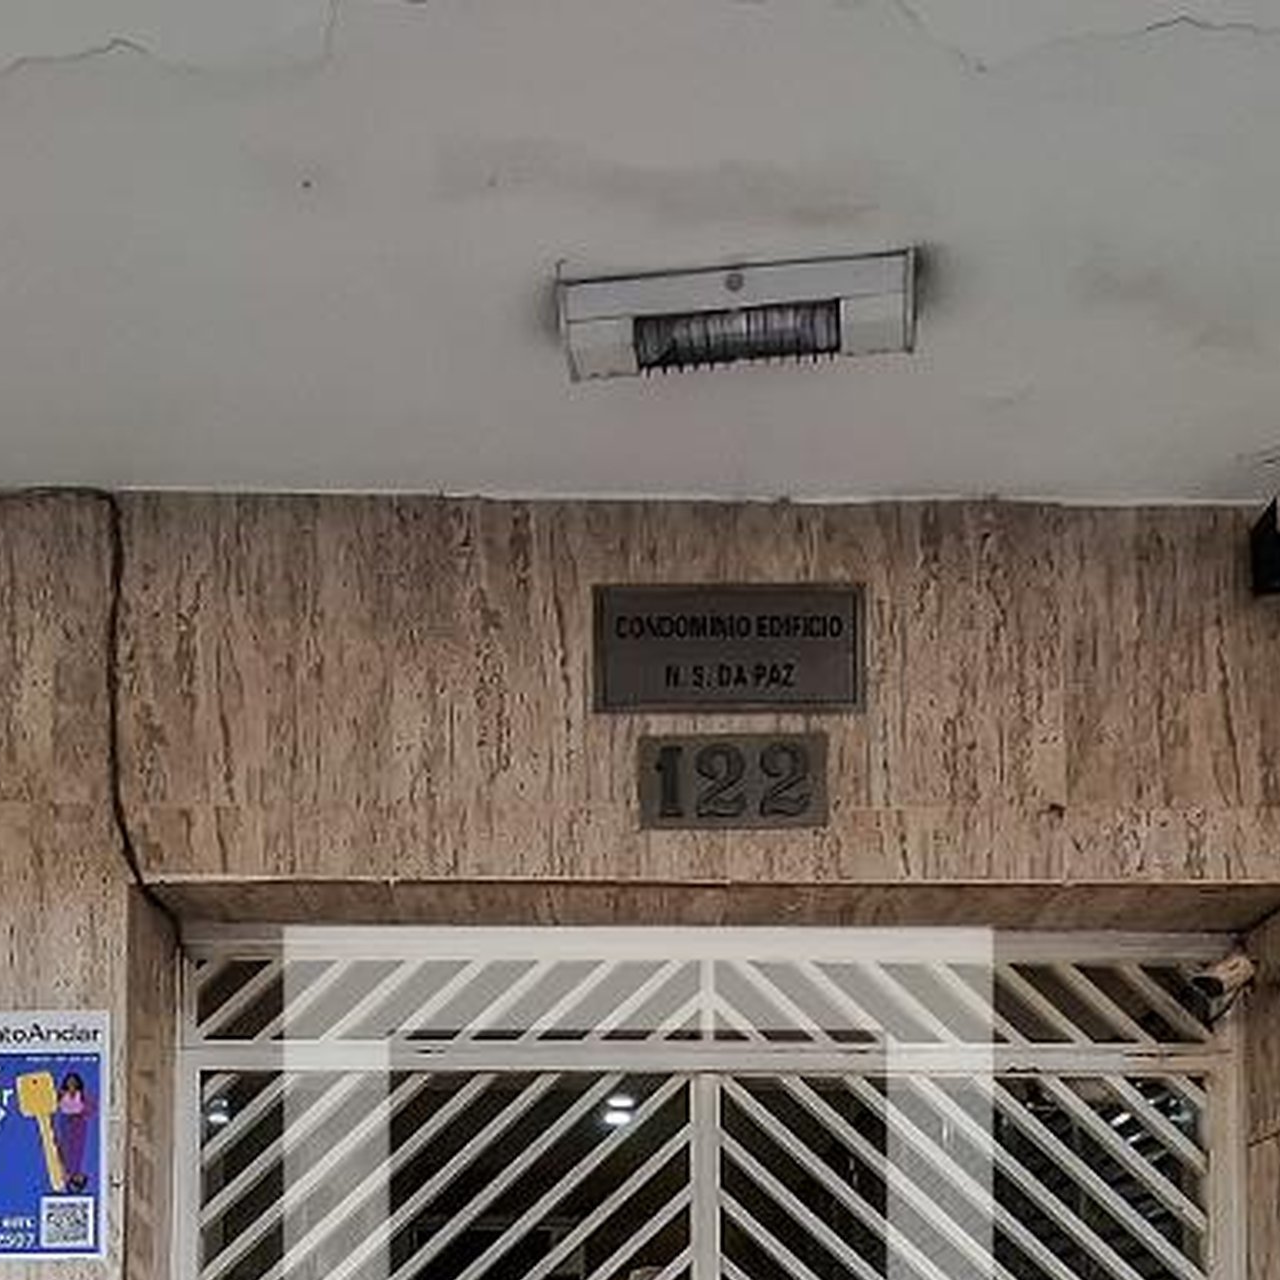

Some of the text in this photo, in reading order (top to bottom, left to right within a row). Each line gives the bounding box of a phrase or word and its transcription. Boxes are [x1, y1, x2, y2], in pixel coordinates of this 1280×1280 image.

[717, 663, 748, 687] DA
[754, 663, 797, 688] PAZ
[653, 741, 811, 819] 122
